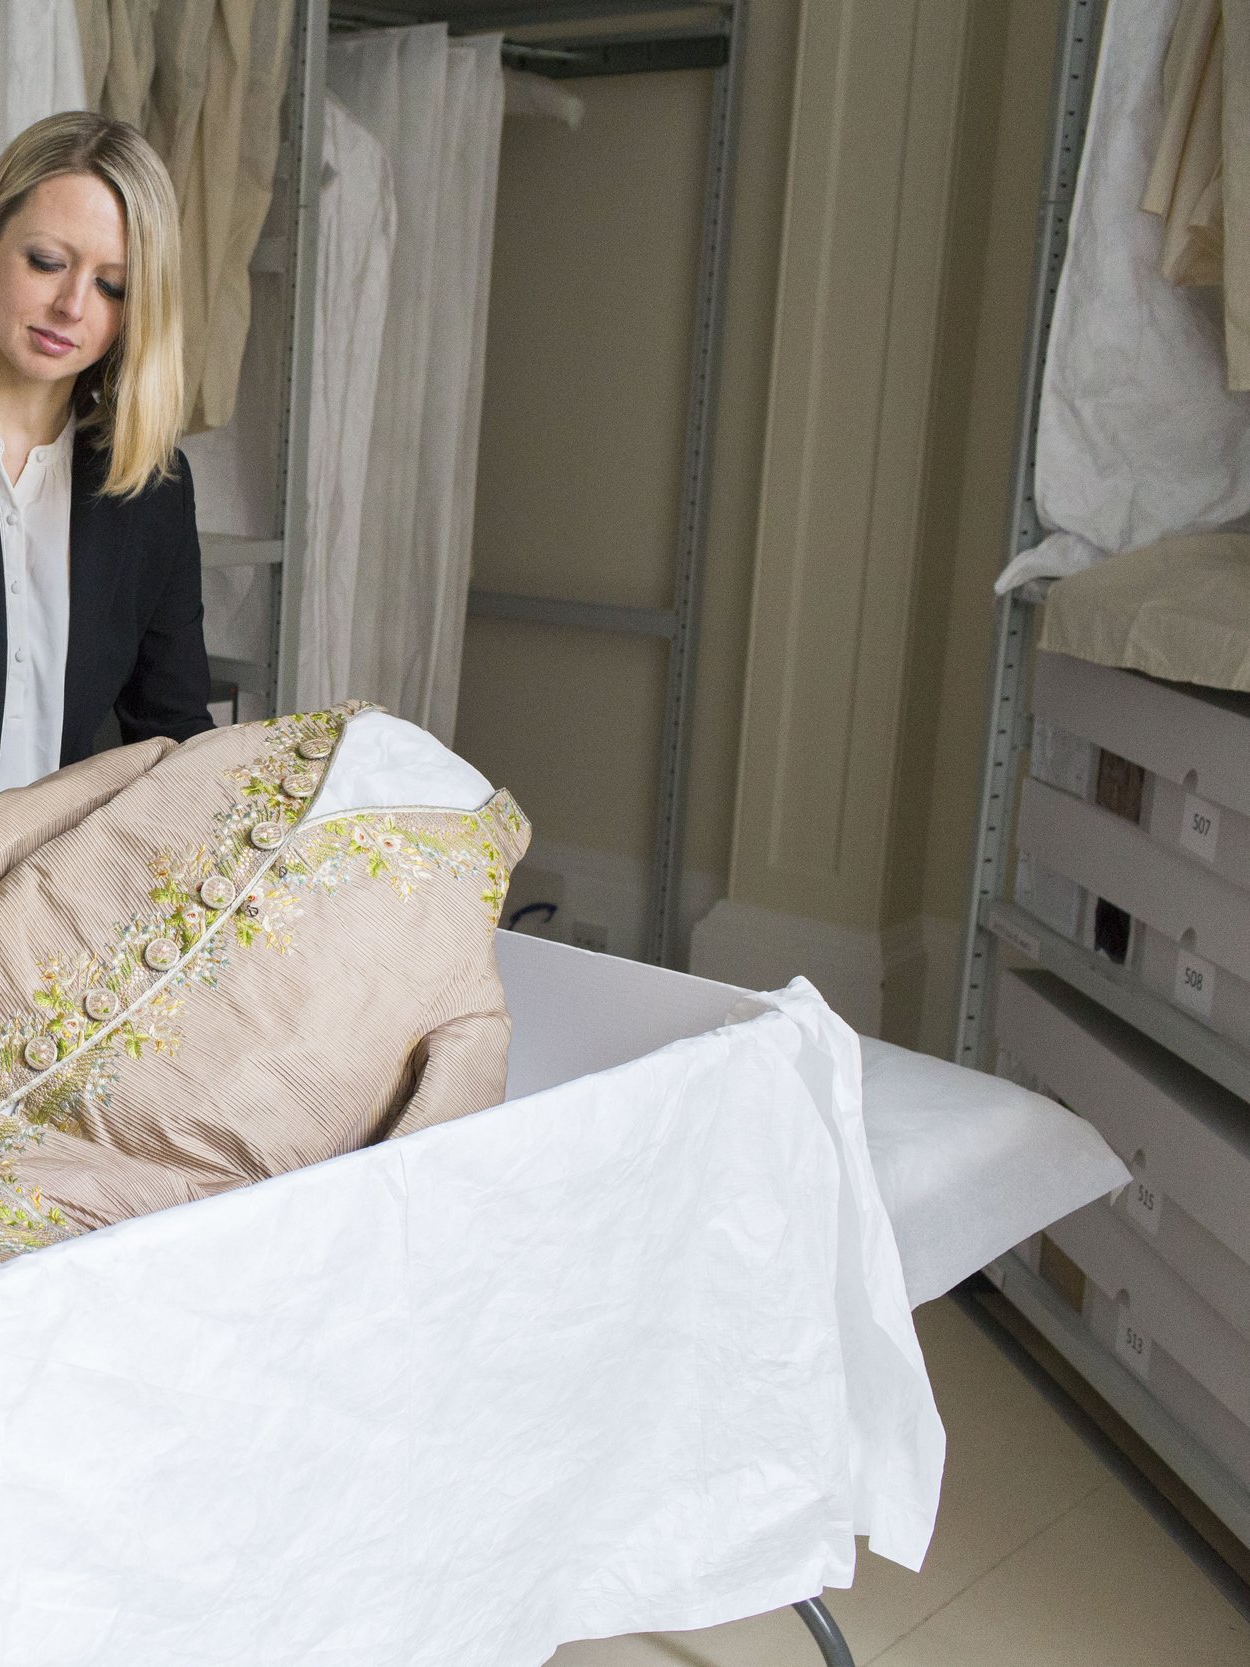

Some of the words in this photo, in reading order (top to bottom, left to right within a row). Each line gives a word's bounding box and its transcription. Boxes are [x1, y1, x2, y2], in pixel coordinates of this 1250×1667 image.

[1192, 813, 1211, 836] 507
[1185, 967, 1203, 991] 508
[1138, 1184, 1155, 1211] 515
[1126, 1327, 1143, 1354] 513
